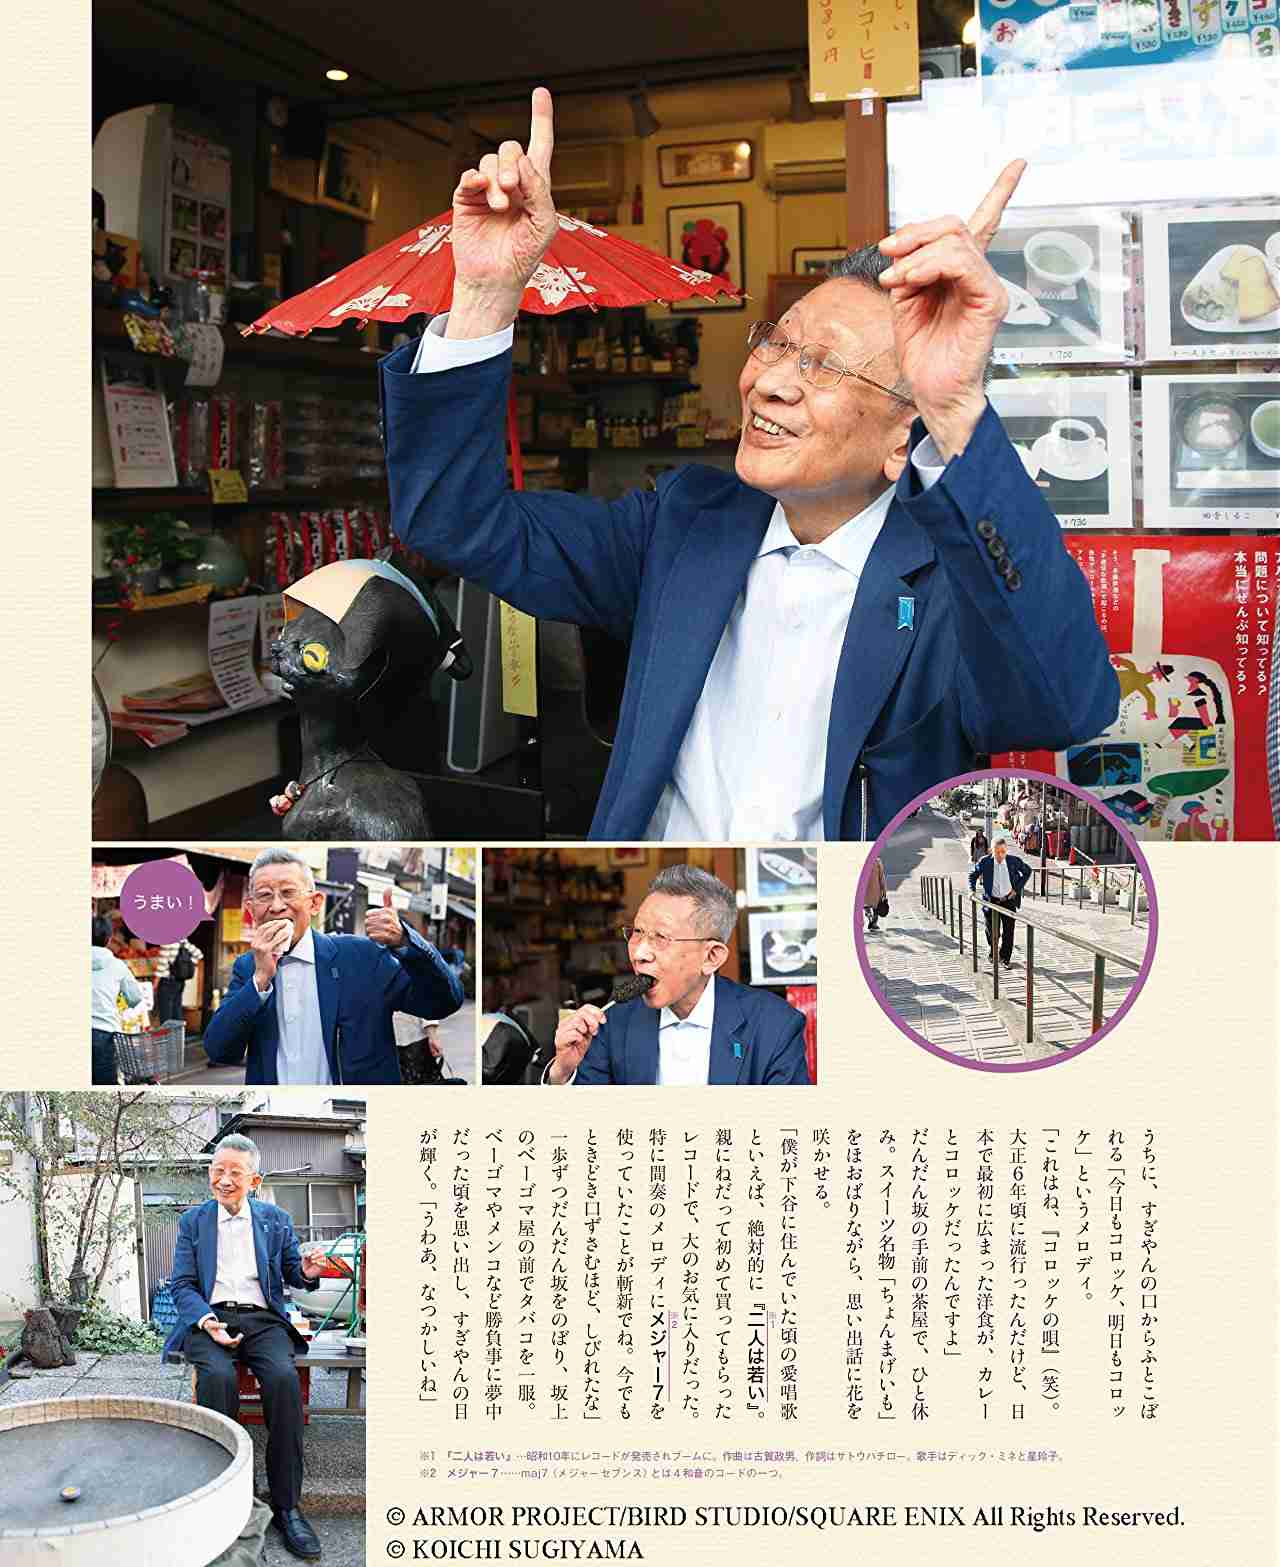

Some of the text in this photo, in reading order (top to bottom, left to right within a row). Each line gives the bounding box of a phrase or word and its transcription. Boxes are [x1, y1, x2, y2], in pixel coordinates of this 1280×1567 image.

[1233, 551, 1249, 696] 本当にぜんぶ知ってる？
[1254, 551, 1269, 696] 問題について知ってる？
[419, 1129, 437, 1401] が輝く。「うわあ、なつかしいね」
[485, 1129, 504, 1420] ベーゴマやメンコなど勝負事に夢中
[518, 1130, 536, 1409] のベーゴマ屋の前でタバコを一服。
[550, 1135, 569, 1419] 一歩ずつだんだん坂をのぼり、坂上
[583, 1129, 601, 1419] ときどき口ずさむほど、しびれたな」
[617, 1128, 634, 1420] 使っていたことが斬新でね。今でも
[649, 1128, 667, 1419] 特に間奏のメロディにメジャー7を
[682, 1131, 699, 1418] レコードで、大のお気に入りだった。
[715, 1129, 732, 1419] 親にねだって初めて買ってもらった
[813, 1128, 831, 1208] 咲かせる。
[846, 1129, 863, 1419] をほおばりながら、思い出話に花を
[878, 1129, 896, 1419] み。スイーツ名物「ちょんまげいも」
[912, 1128, 929, 1420] だんだん坂の手前の茶屋で、ひと休
[944, 1129, 961, 1355] とコロッケだったんですよ」
[976, 1129, 994, 1419] 本で最初に広まった洋食が、カレー
[1009, 1128, 1027, 1419] 大正6年頃に流行ったんだけど、日
[1074, 1130, 1093, 1300] ケ」というメロディ。
[1107, 1129, 1125, 1417] れる「今日もコロッケ、明日もコロッ
[1141, 1129, 1159, 1419] うちに、すぎやんの口からふとこぼ
